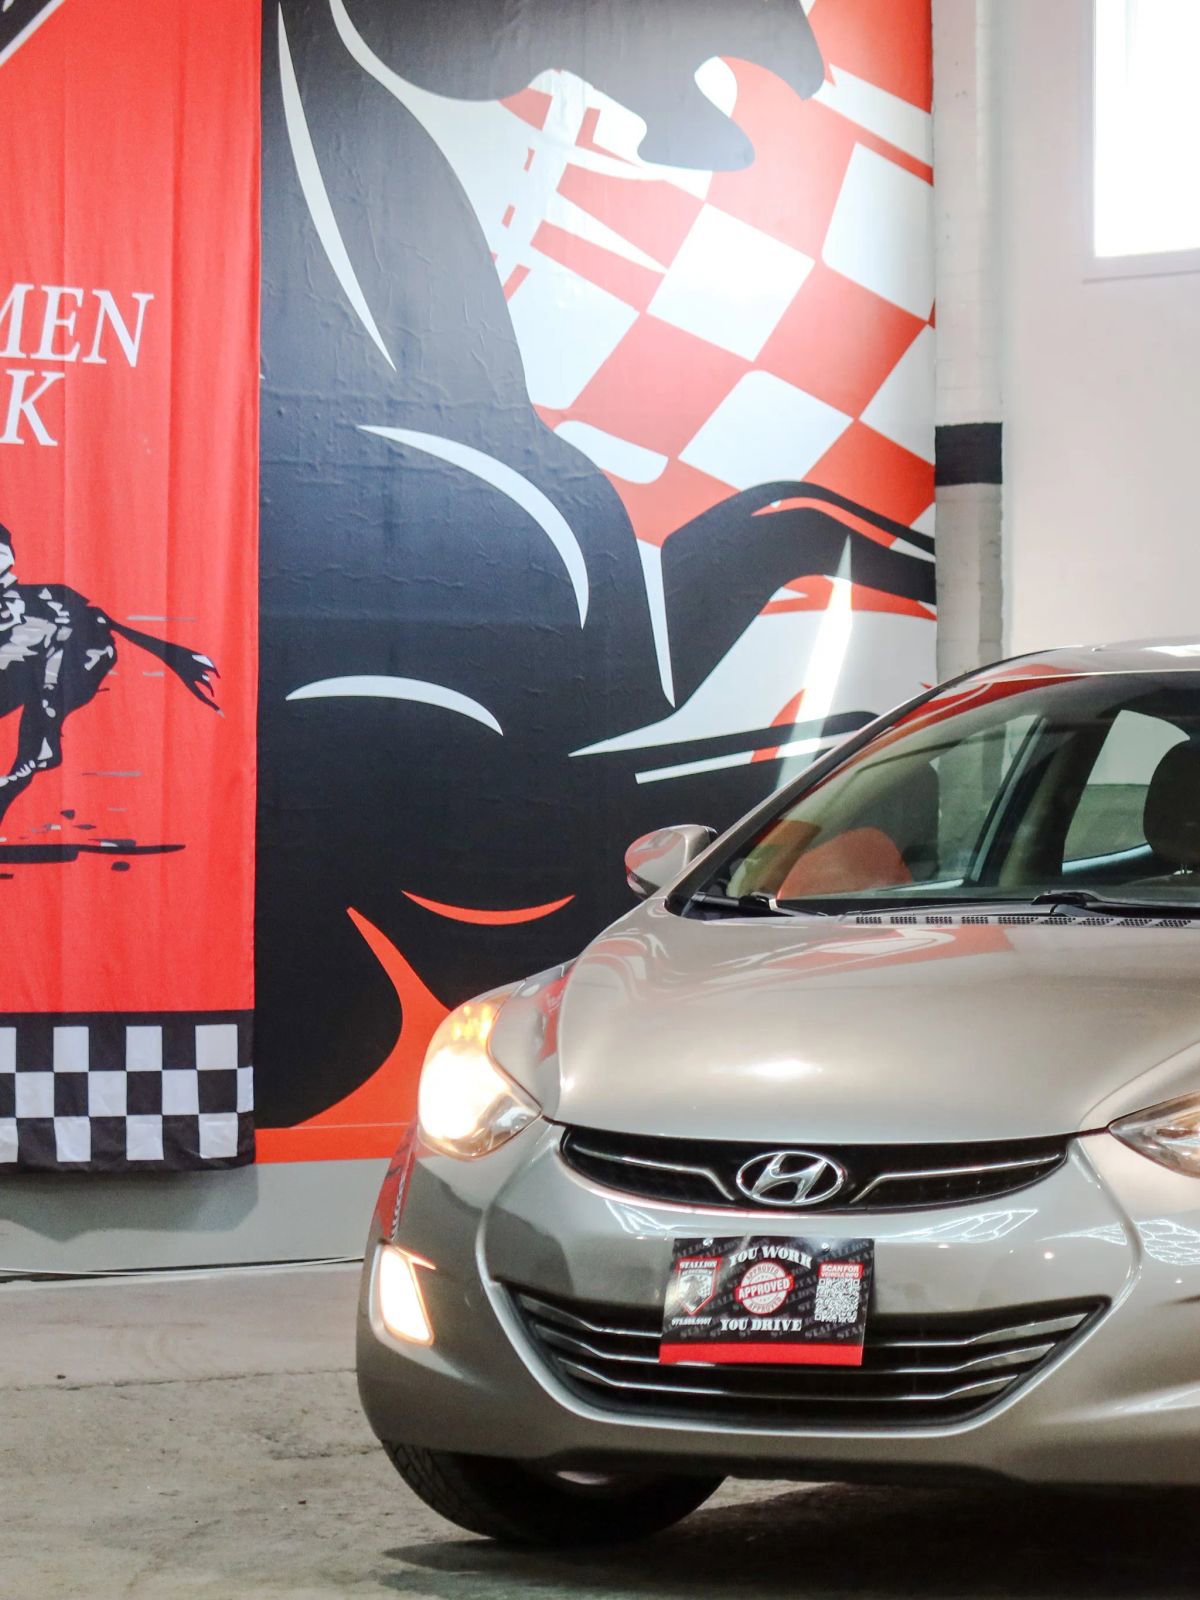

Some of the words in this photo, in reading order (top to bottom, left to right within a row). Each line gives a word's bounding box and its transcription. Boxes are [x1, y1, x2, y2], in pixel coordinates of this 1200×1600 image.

[729, 1247, 759, 1267] YOU
[762, 1245, 813, 1269] WORK
[680, 1260, 718, 1269] STALLION
[821, 1264, 843, 1273] SCAN
[843, 1264, 860, 1273] FOR
[738, 1278, 791, 1300] APPROVED
[720, 1318, 749, 1332] YOU
[750, 1318, 803, 1332] DRIVE
